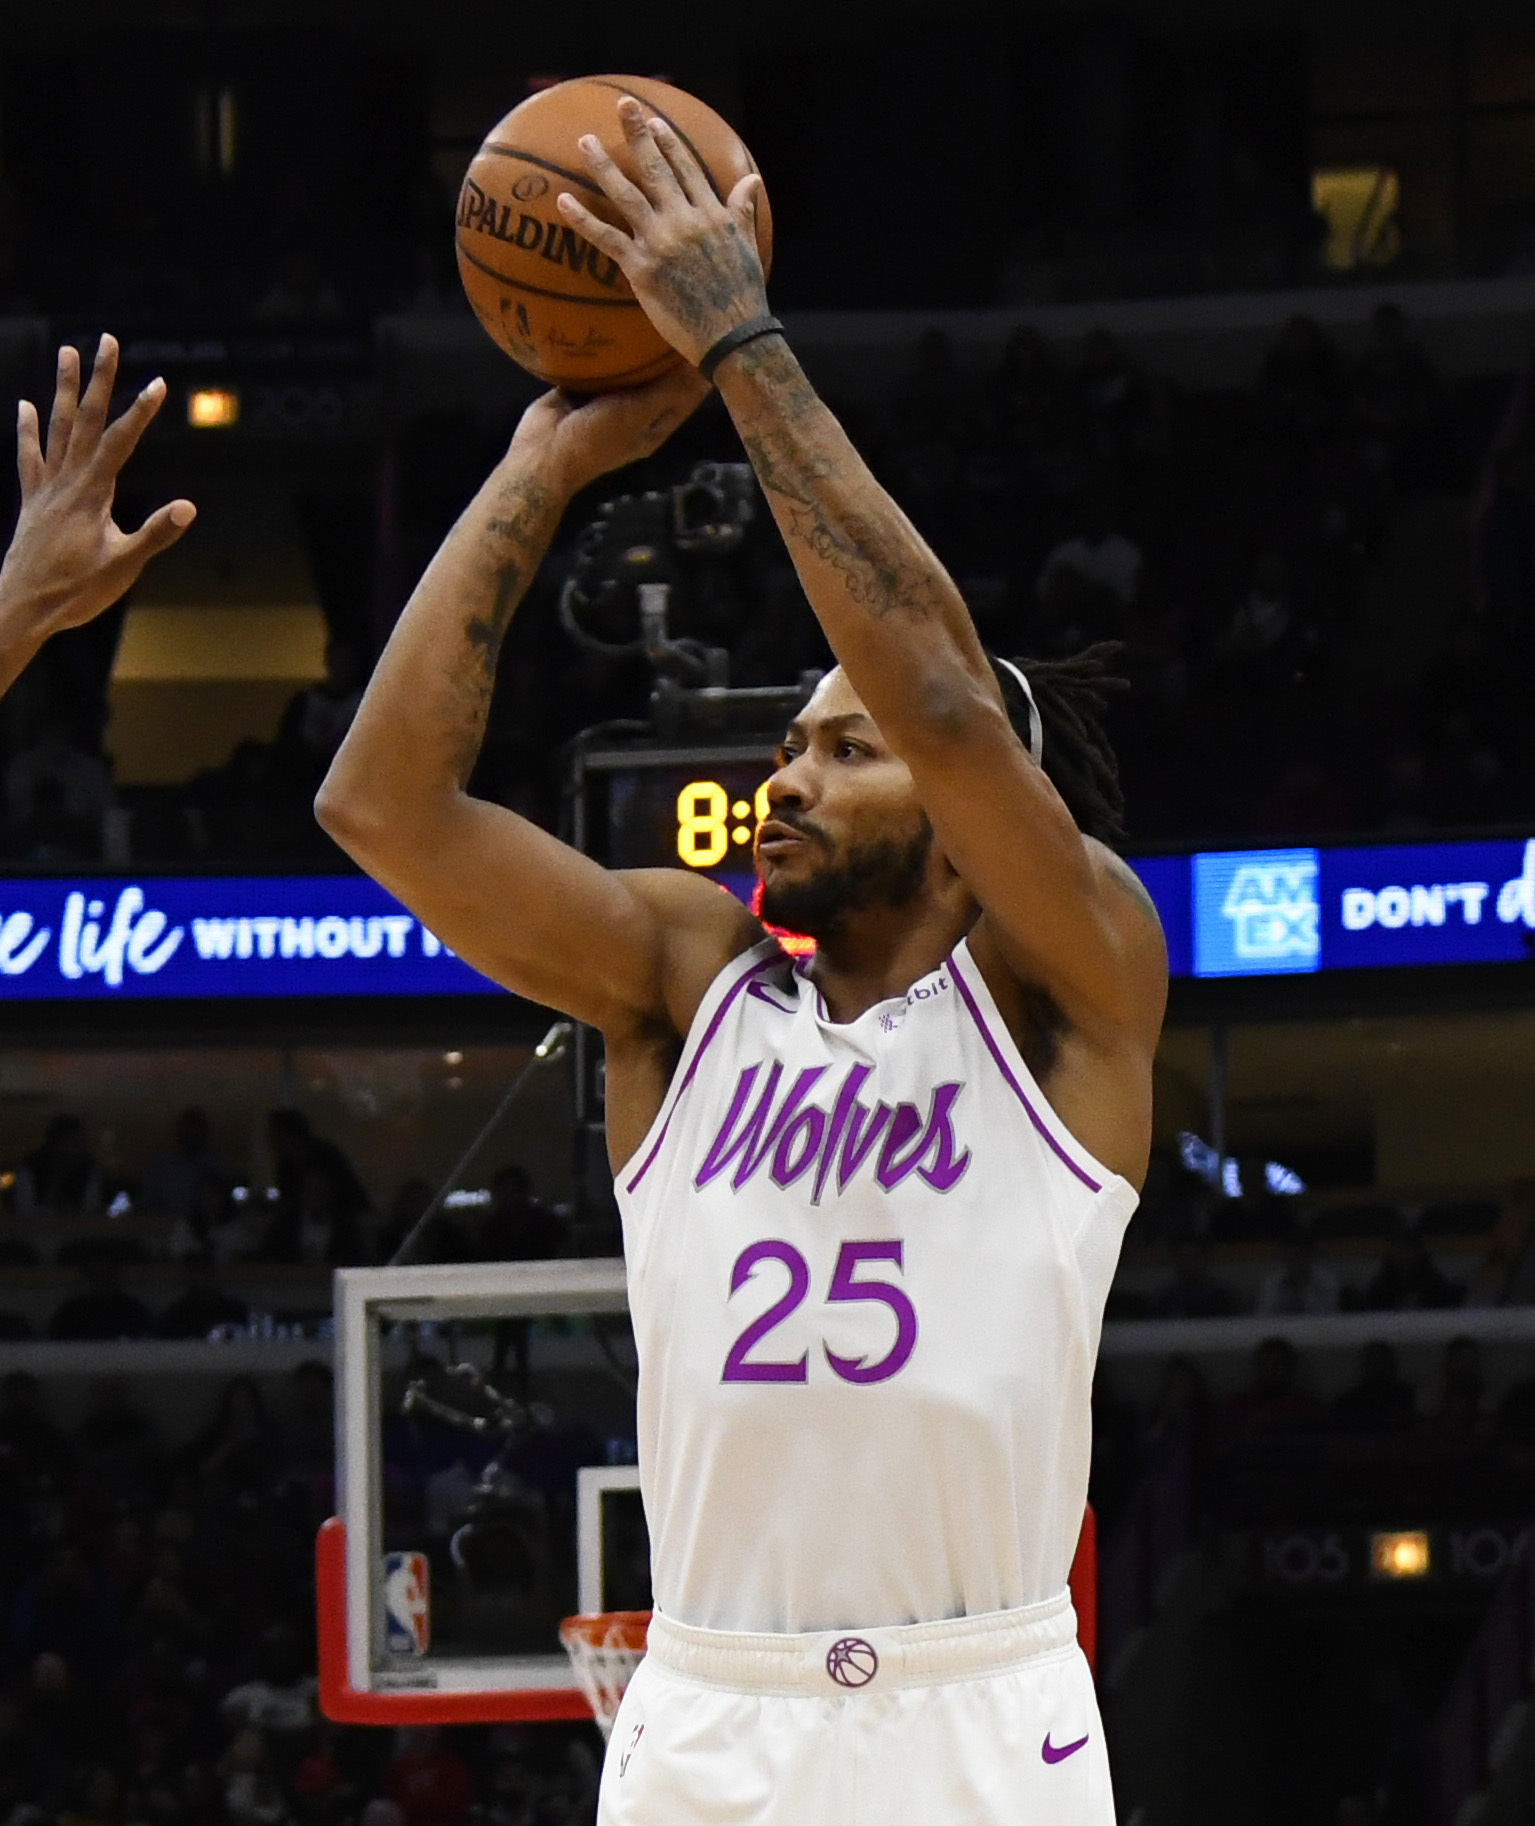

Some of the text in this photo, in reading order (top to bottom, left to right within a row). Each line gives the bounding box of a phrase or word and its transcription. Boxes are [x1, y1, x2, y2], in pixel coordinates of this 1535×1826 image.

[677, 781, 771, 867] 8:
[61, 886, 183, 987] life
[192, 914, 412, 960] WITHOUT
[1342, 881, 1489, 930] DON'T
[693, 1058, 973, 1207] Wolves
[719, 1237, 919, 1386] 25
